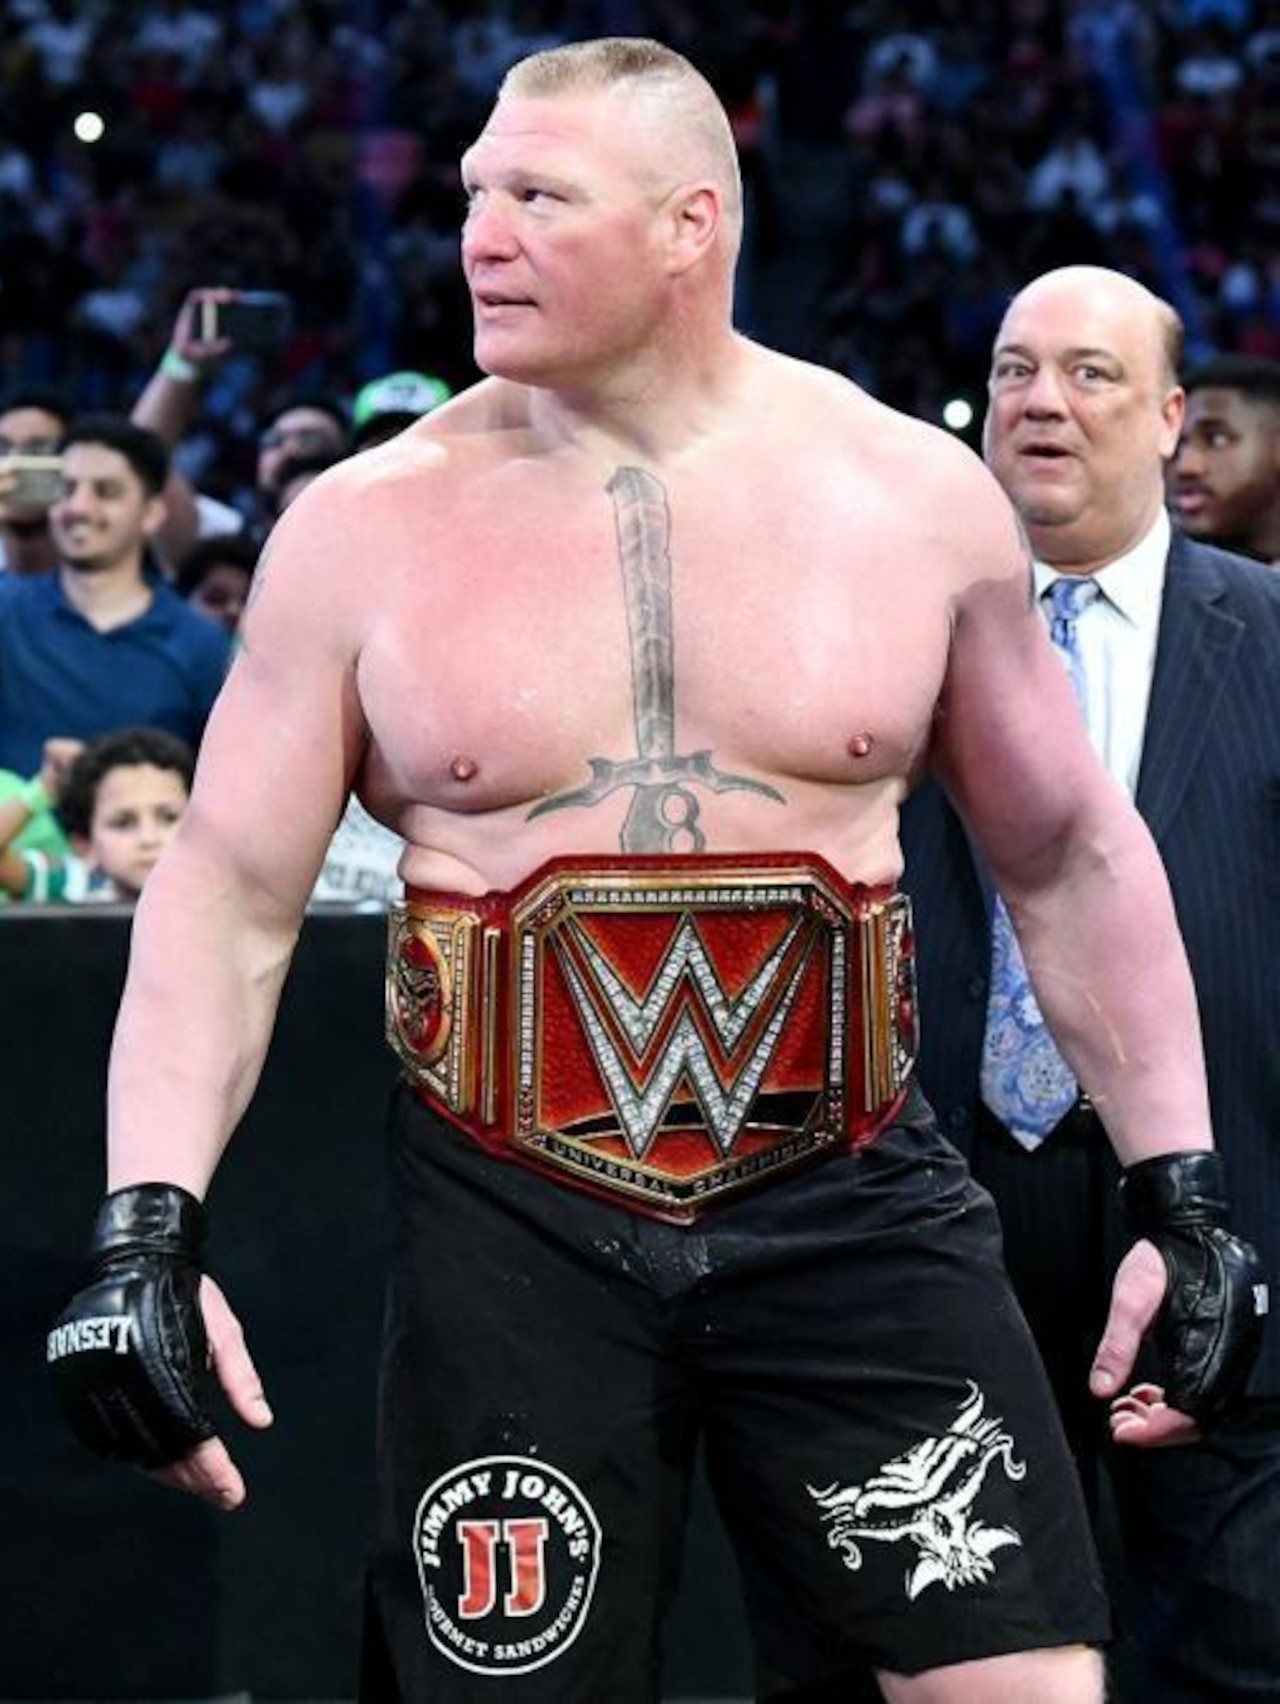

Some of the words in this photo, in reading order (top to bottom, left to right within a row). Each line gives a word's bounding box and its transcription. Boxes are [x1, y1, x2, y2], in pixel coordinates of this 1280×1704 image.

[553, 1140, 674, 1196] UNIVERSAL
[421, 1470, 493, 1569] JIMMY
[501, 1470, 590, 1558] JOHN'S
[456, 1516, 550, 1620] JJ
[428, 1584, 489, 1658] OURMET
[493, 1575, 585, 1660] SANDWICHES
